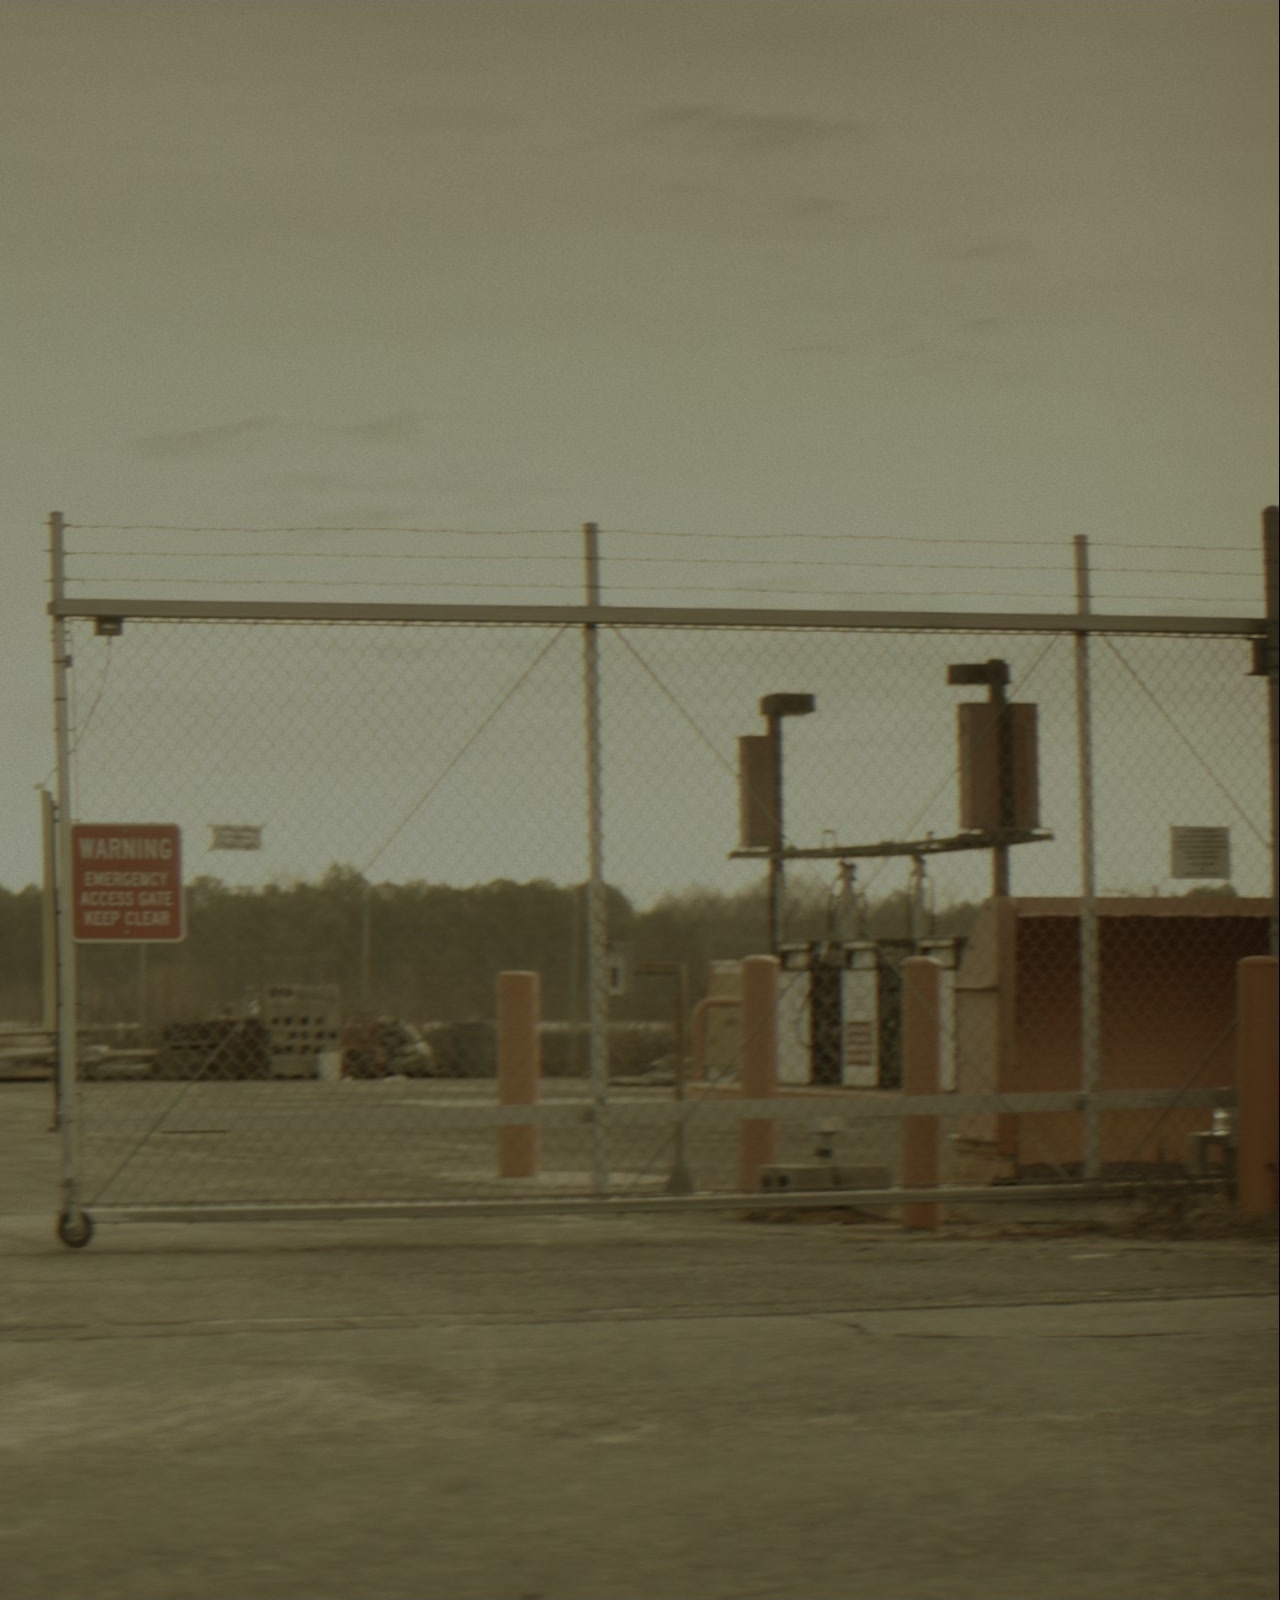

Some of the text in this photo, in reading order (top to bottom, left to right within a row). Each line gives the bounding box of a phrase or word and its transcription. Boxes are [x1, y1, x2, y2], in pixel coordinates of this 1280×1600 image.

[79, 837, 172, 860] WARNING
[83, 871, 169, 887] EMERGENCY
[79, 890, 175, 906] ACCESS GATE
[83, 910, 171, 926] KEEP CLEAR
